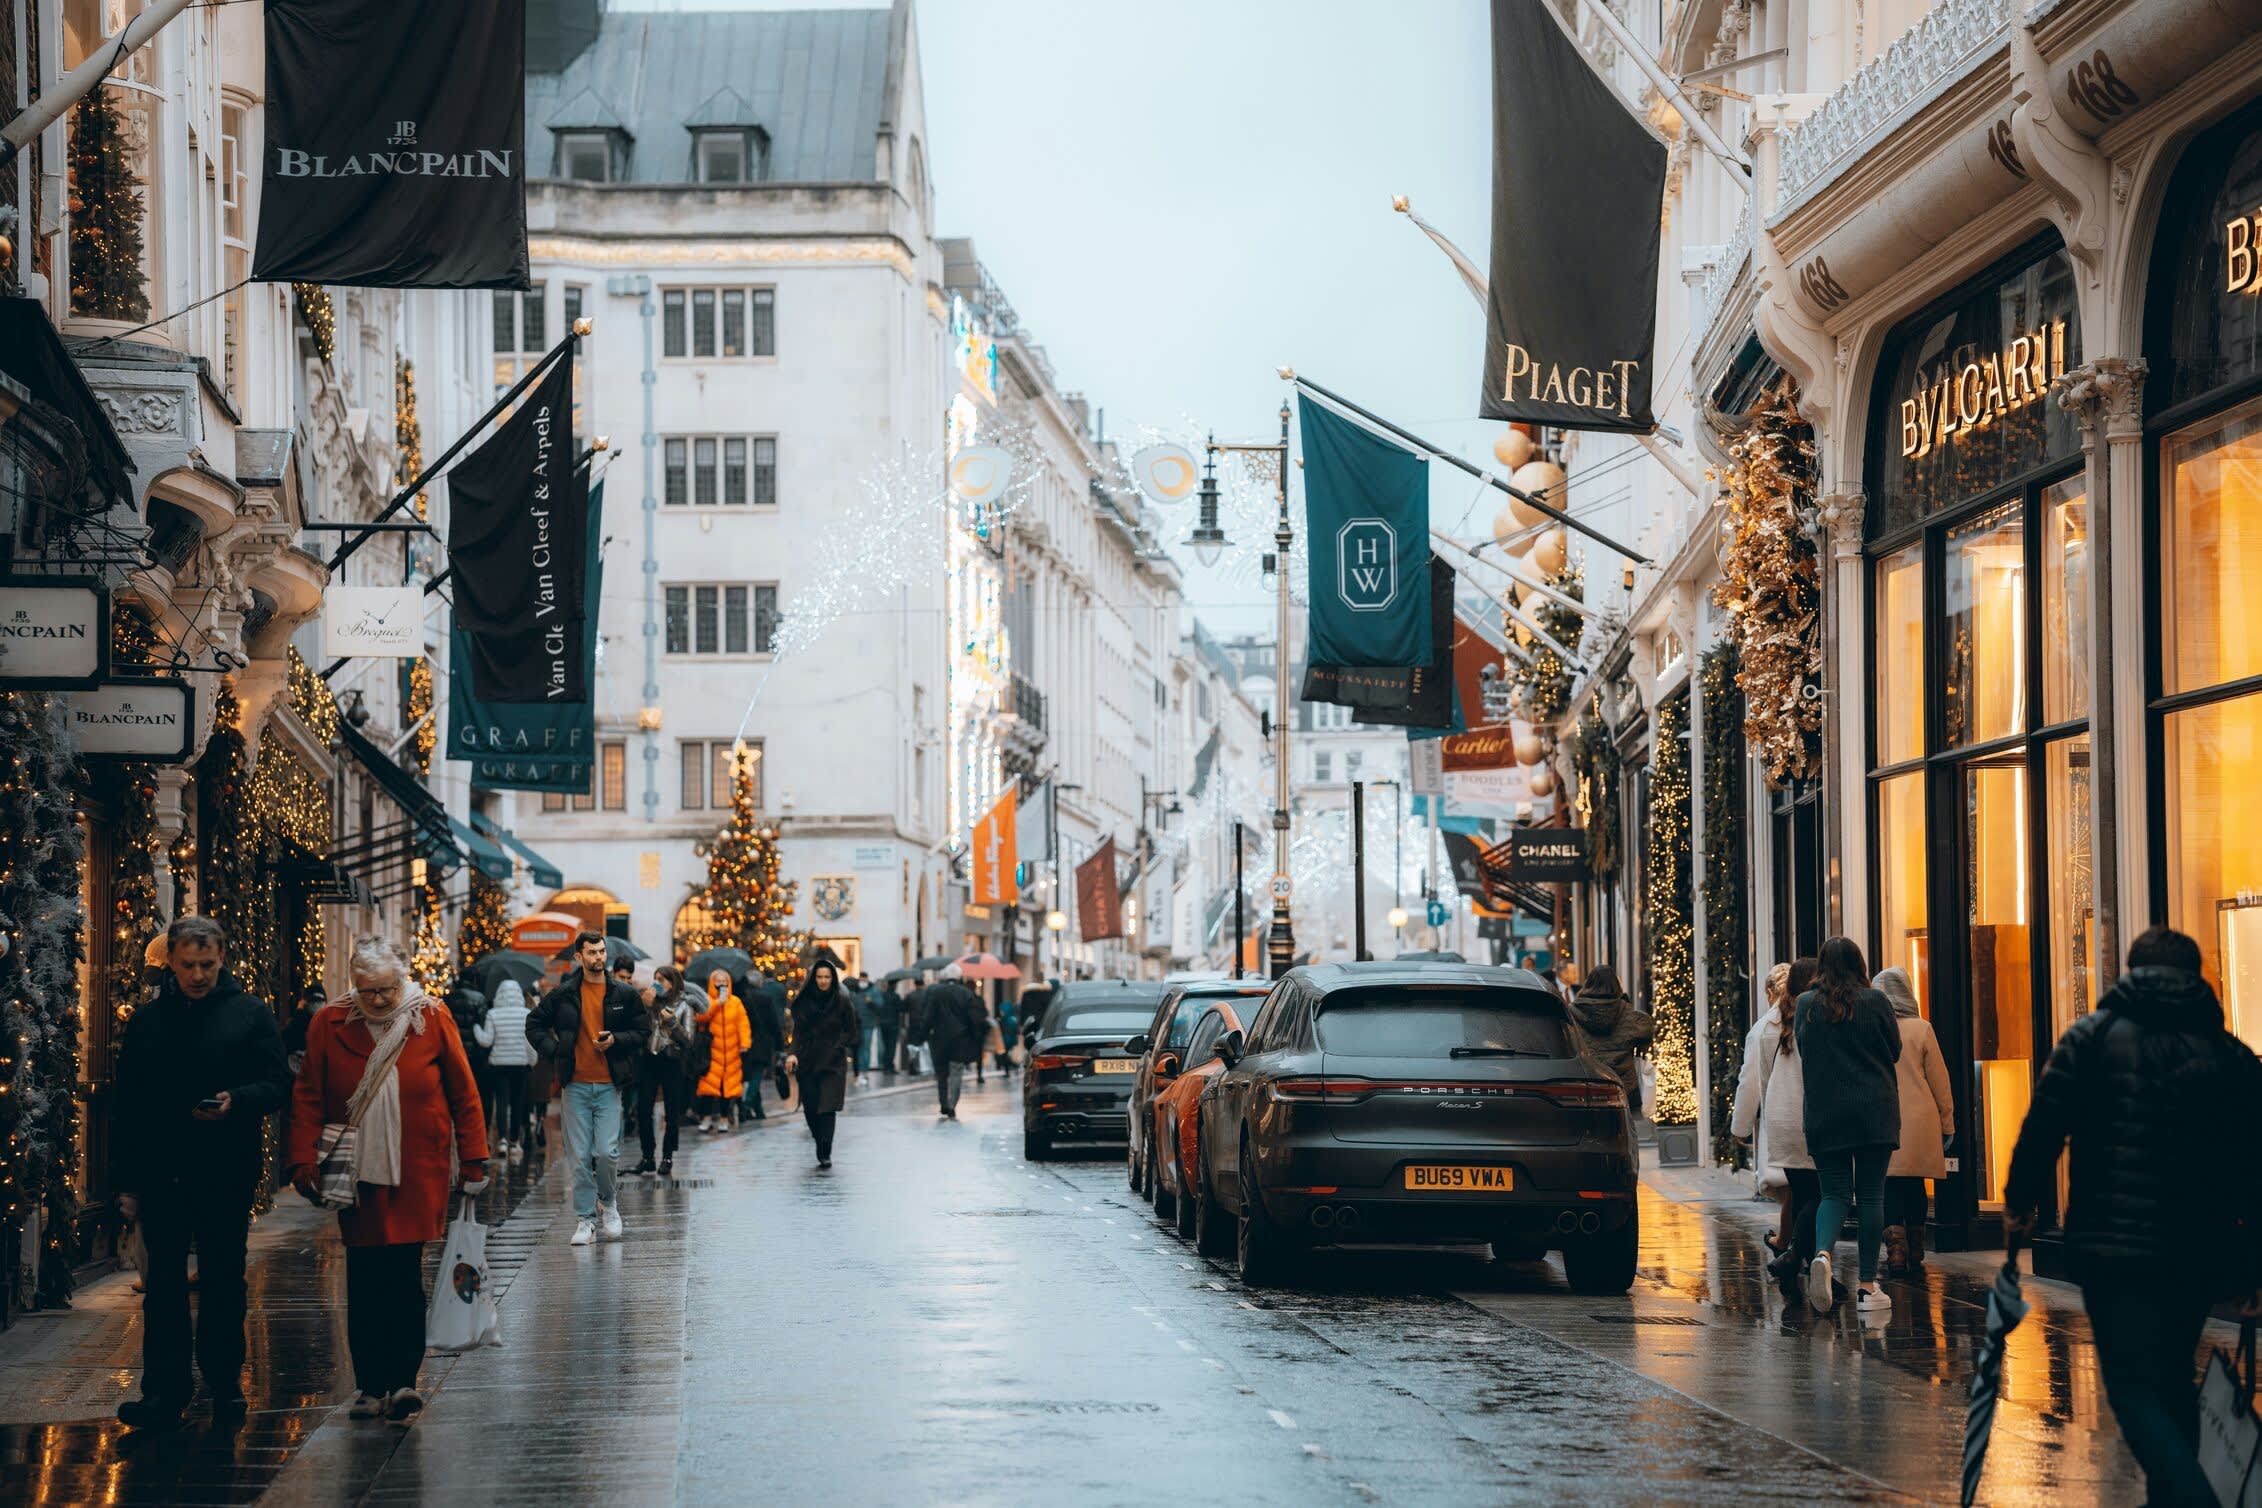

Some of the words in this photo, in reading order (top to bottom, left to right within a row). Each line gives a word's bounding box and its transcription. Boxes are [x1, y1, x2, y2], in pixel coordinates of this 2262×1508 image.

[2067, 49, 2140, 123] 168
[1988, 112, 2029, 178] 16
[276, 148, 513, 178] BLANCPAIN
[1800, 256, 1849, 311] 168
[1502, 343, 1640, 418] PIAGET
[1901, 323, 2049, 457] BVLGARI
[532, 406, 550, 476] Arpels
[535, 483, 550, 500] &
[531, 507, 550, 569] Cleef
[536, 574, 556, 618] Van
[0, 624, 86, 638] NCPAIN
[547, 663, 565, 698] Van
[76, 711, 176, 726] BLANCPAIN
[461, 725, 582, 747] GRAFF
[1442, 736, 1510, 754] Cartier
[482, 761, 582, 780] GRAFF
[1519, 845, 1580, 857] CHANEL
[1273, 881, 1290, 892] 20
[1403, 1087, 1514, 1095] PORSCHE
[1436, 1101, 1470, 1109] Macan
[1471, 1101, 1483, 1109] S
[1414, 1168, 1464, 1186] BU69
[1469, 1168, 1505, 1187] VWA
